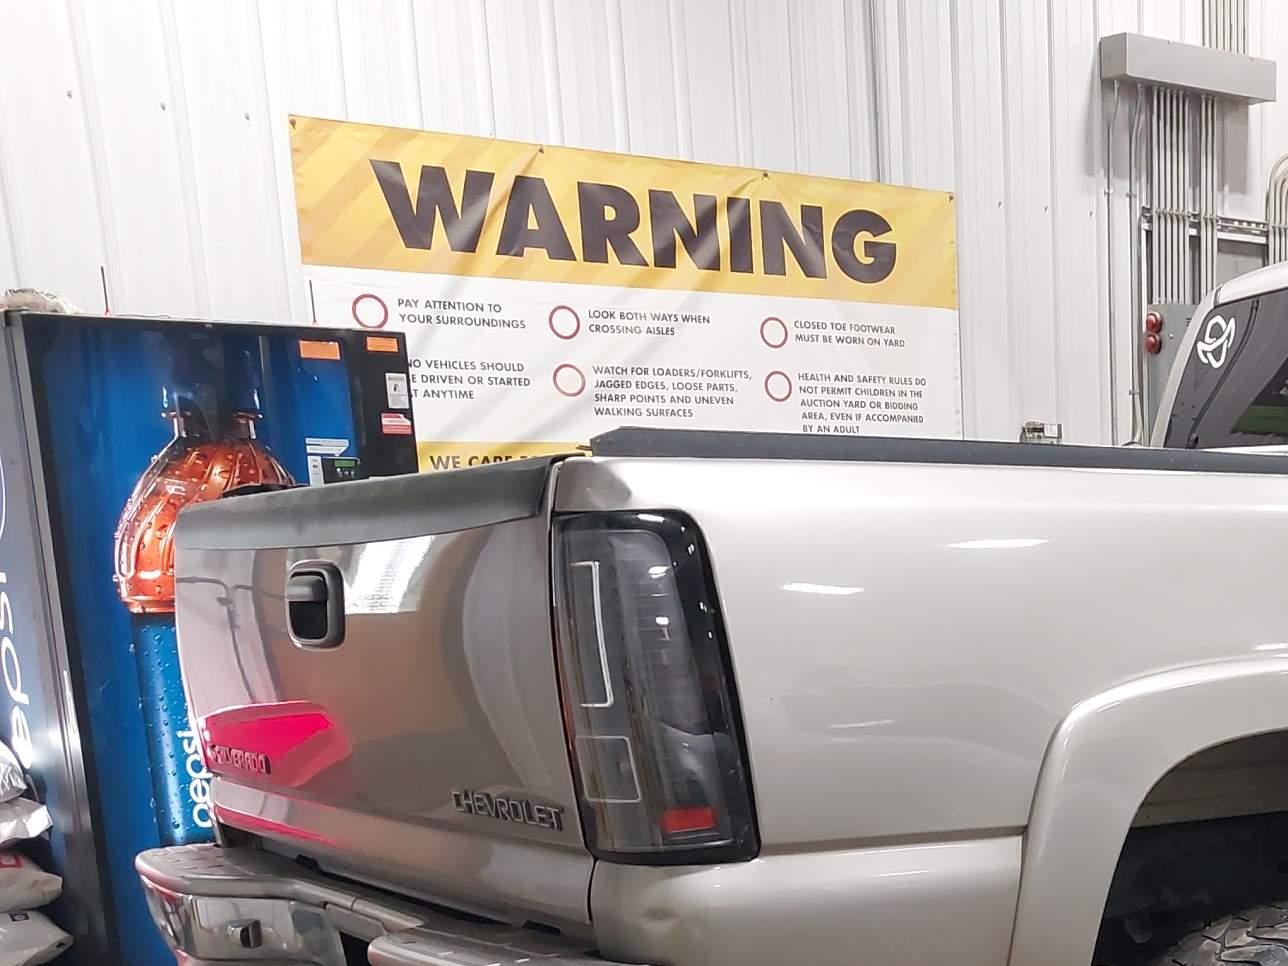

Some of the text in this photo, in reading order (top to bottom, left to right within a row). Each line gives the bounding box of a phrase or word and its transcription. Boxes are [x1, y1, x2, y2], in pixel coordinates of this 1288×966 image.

[369, 159, 897, 284] WARNING
[398, 299, 502, 313] PAY ATTENTION TO
[399, 313, 526, 329] YOUR SURROUNDINGS
[588, 310, 710, 324] LOOK BOTH WAYS WHEN
[588, 324, 675, 336] CROSSING AISLES
[794, 320, 896, 334] CLOSED TOE FOOTWEAR
[795, 333, 906, 348] MUST BE WORN ON YARD
[426, 359, 477, 371] VEHICLES
[480, 362, 525, 372] SHOULD
[592, 366, 752, 381] WATCH FOR LOADERS/FORKLIFTS,
[798, 372, 927, 386] HEALTH AND SAFETY RULES DO
[421, 375, 464, 385] DRIVEN
[467, 376, 484, 385] OR
[487, 376, 531, 387] STARTED
[594, 380, 738, 394] JAGGED EDGES, LOOSE PARTS,
[423, 389, 475, 400] ANYTIME
[594, 393, 735, 405] SHARP POINTS AND UNEVEN
[799, 385, 923, 399] NOT PERMIT CHILDREN IN THE
[800, 398, 918, 411] AUCTION YARD OR BIDDING
[594, 407, 694, 418] WALKING SURFACES
[801, 411, 924, 424] AREA, EVEN IF ACCOMPANIED
[802, 424, 860, 434] BY AN ADULT
[429, 455, 461, 470] WE
[451, 790, 563, 831] CHEVROLET
